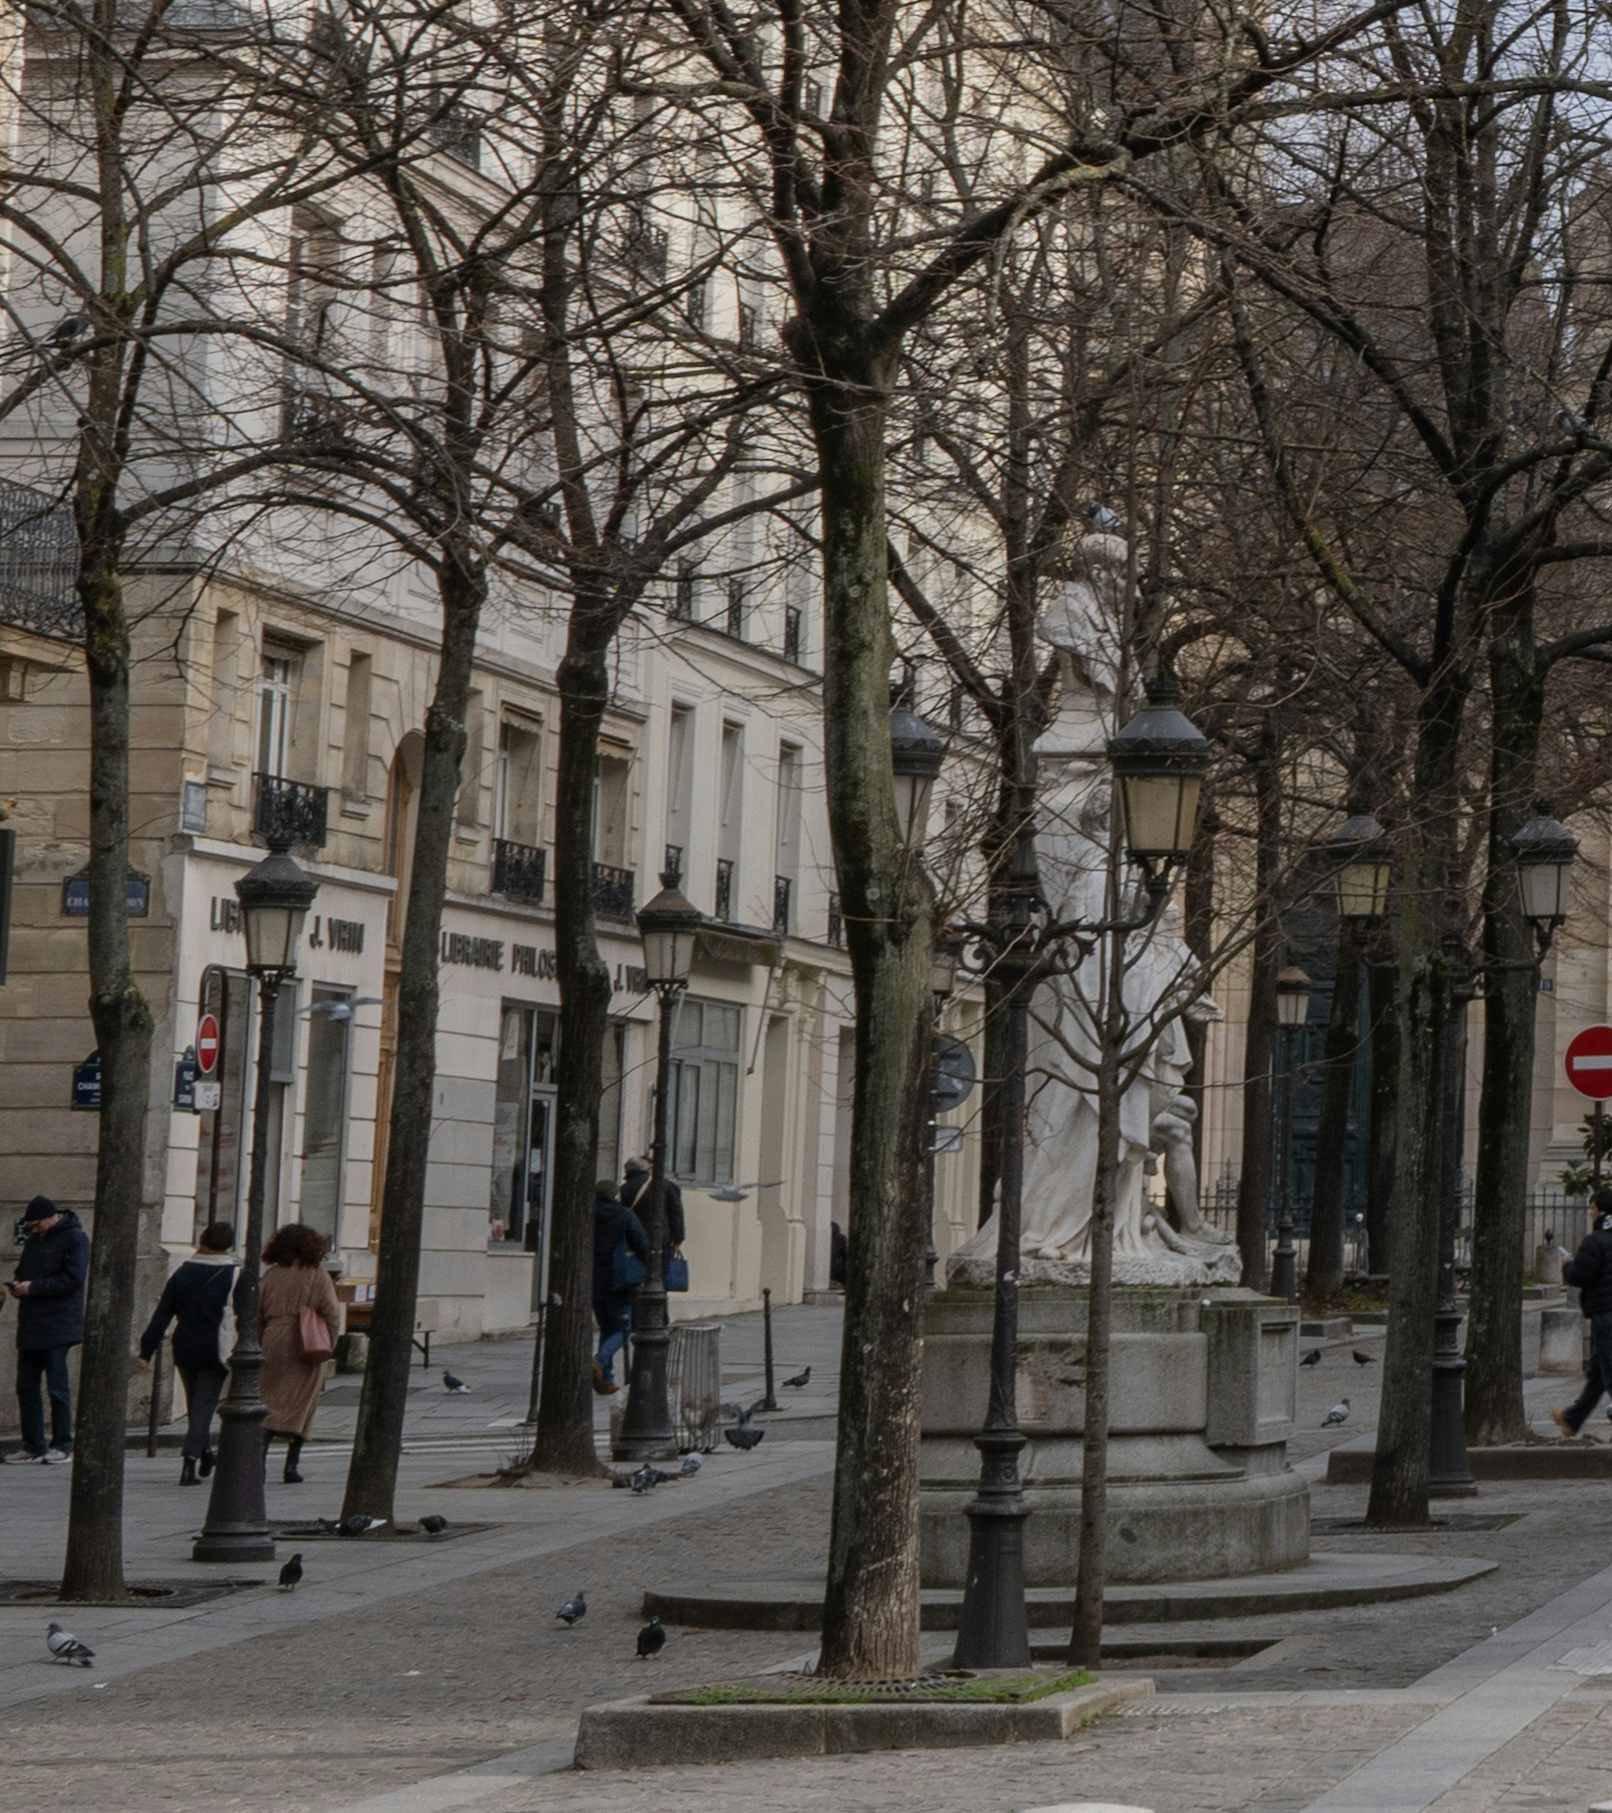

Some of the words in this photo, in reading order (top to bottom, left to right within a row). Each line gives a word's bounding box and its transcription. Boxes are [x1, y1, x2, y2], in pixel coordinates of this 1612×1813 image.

[310, 915, 323, 949] J.
[328, 917, 365, 955] VRIN
[441, 931, 504, 972] LIBRAIRIE
